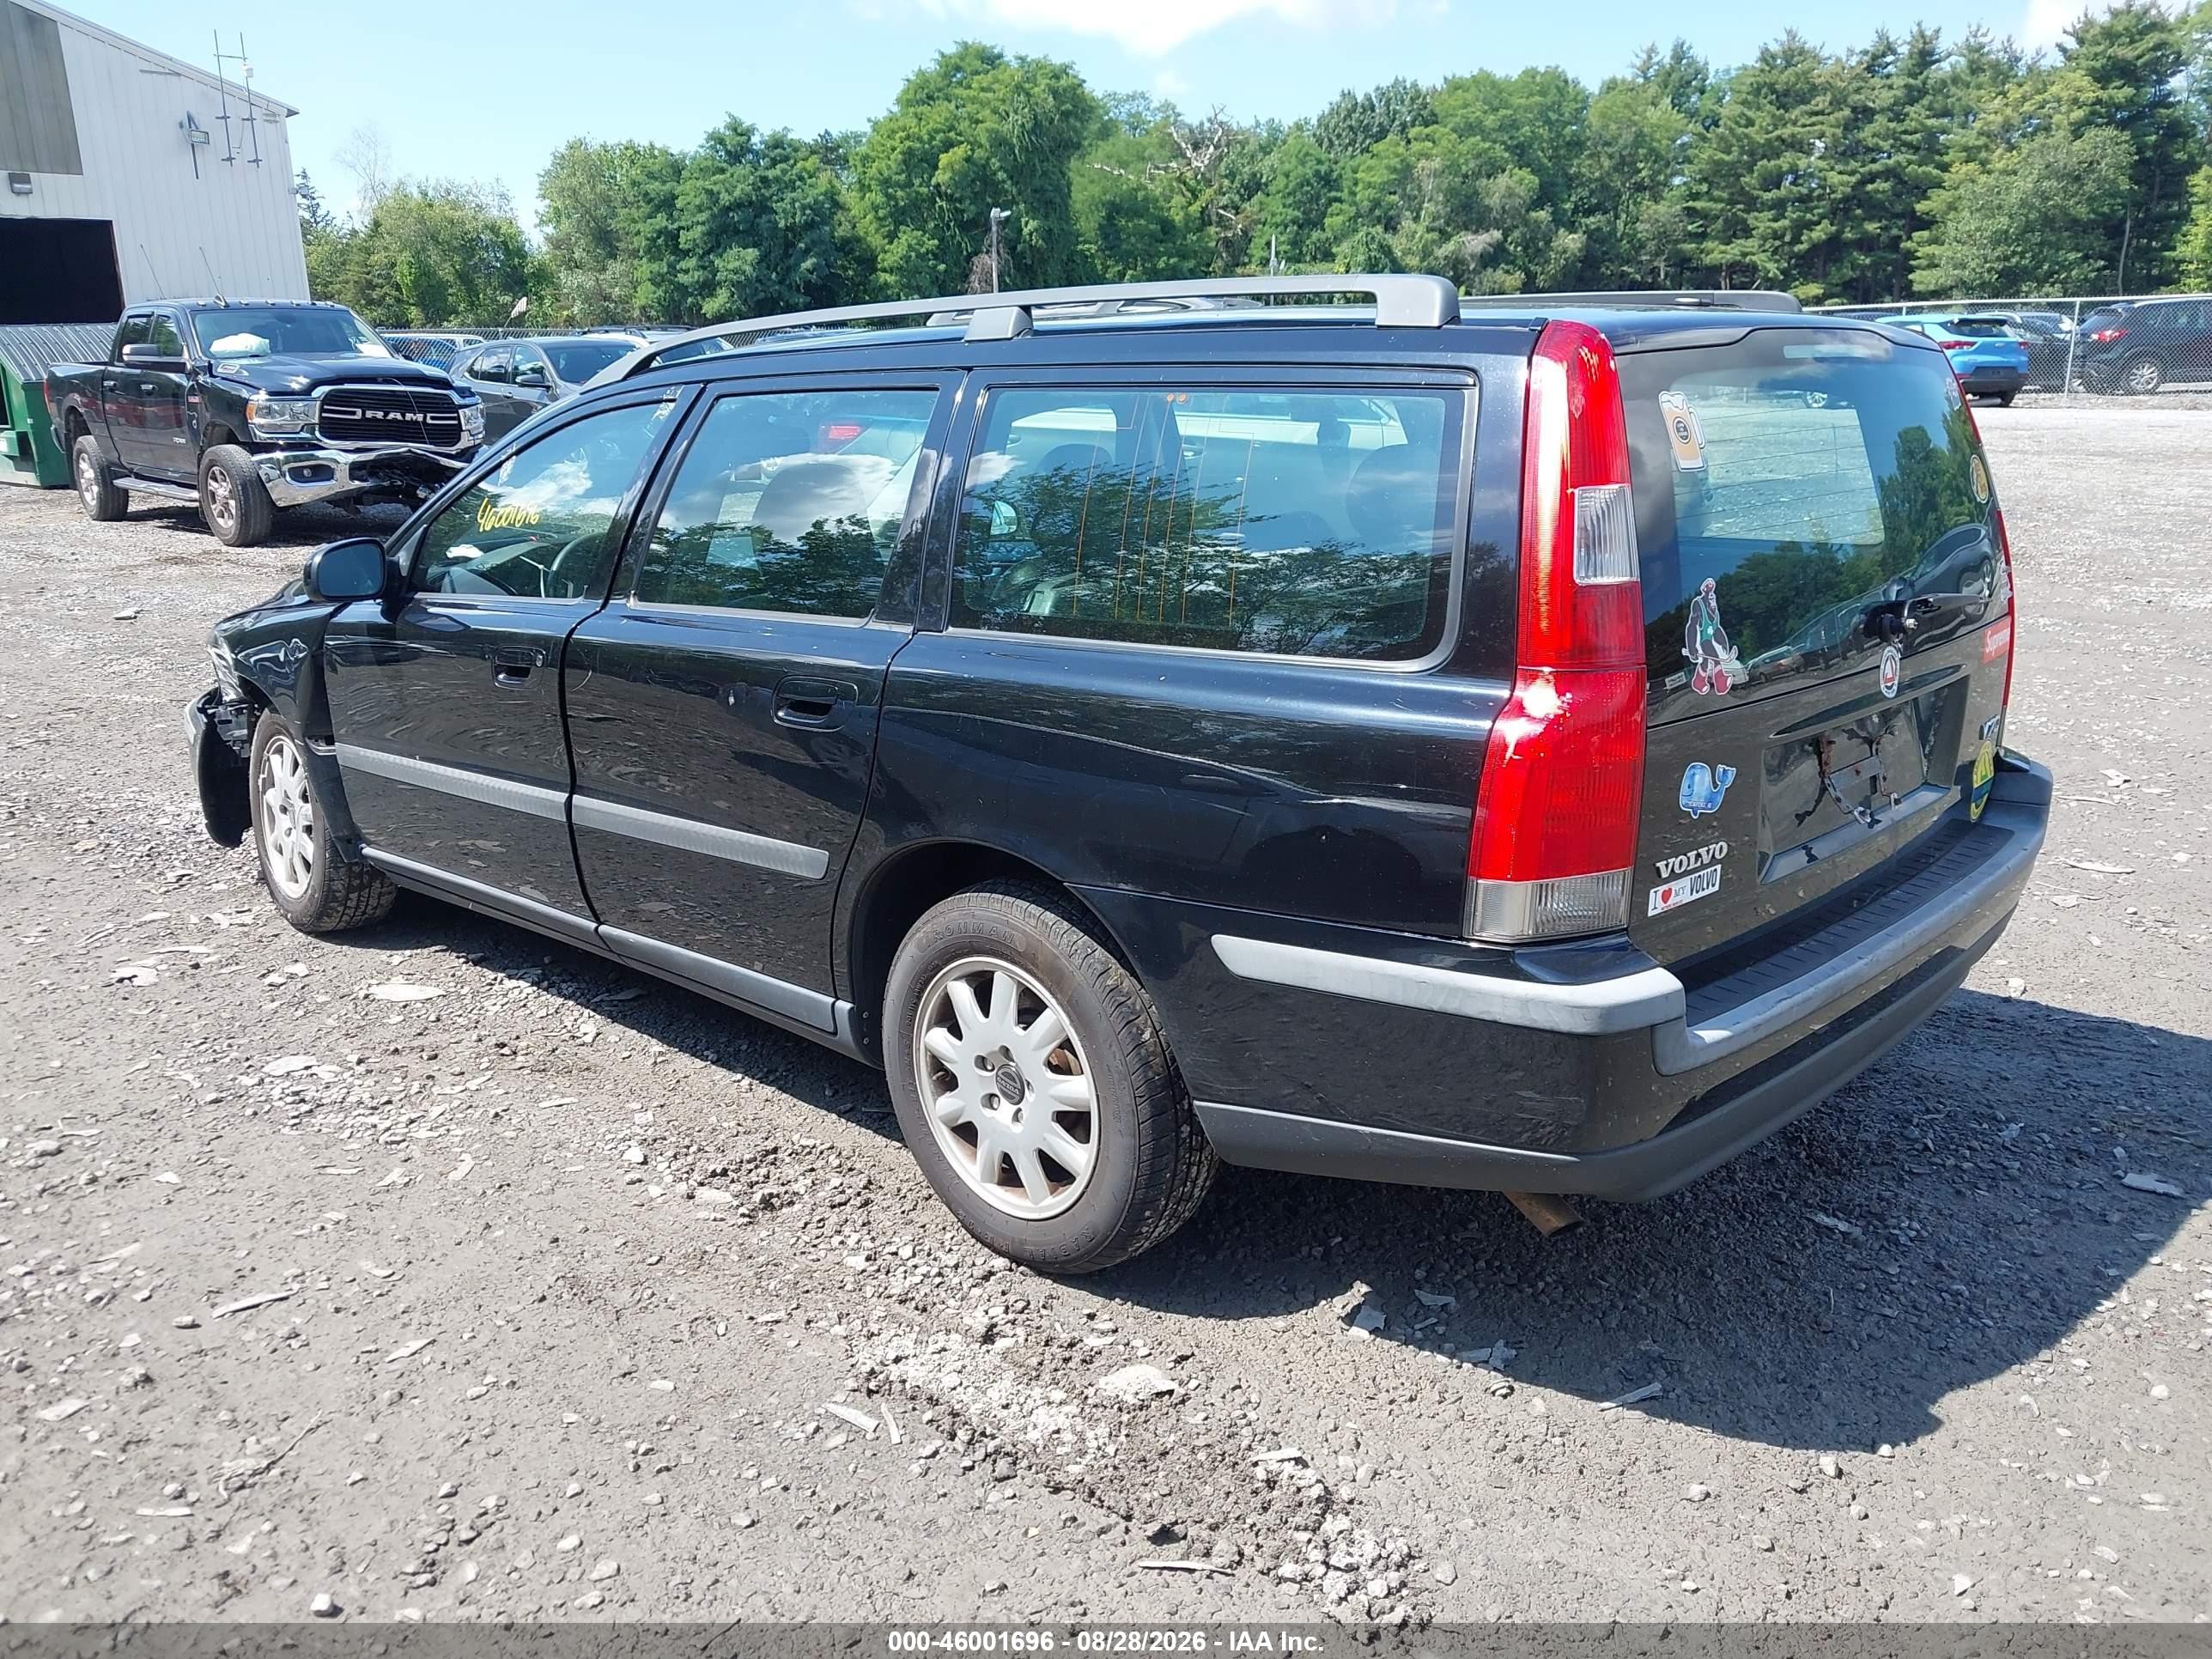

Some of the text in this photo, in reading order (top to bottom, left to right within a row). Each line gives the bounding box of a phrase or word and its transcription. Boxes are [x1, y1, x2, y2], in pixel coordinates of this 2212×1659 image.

[365, 410, 424, 422] RAM
[1656, 842, 1728, 878] VOLVO
[1650, 890, 1660, 911] I
[1674, 886, 1686, 898] MY
[1689, 867, 1718, 896] VOLVO
[997, 1077, 1019, 1095] VOLVO
